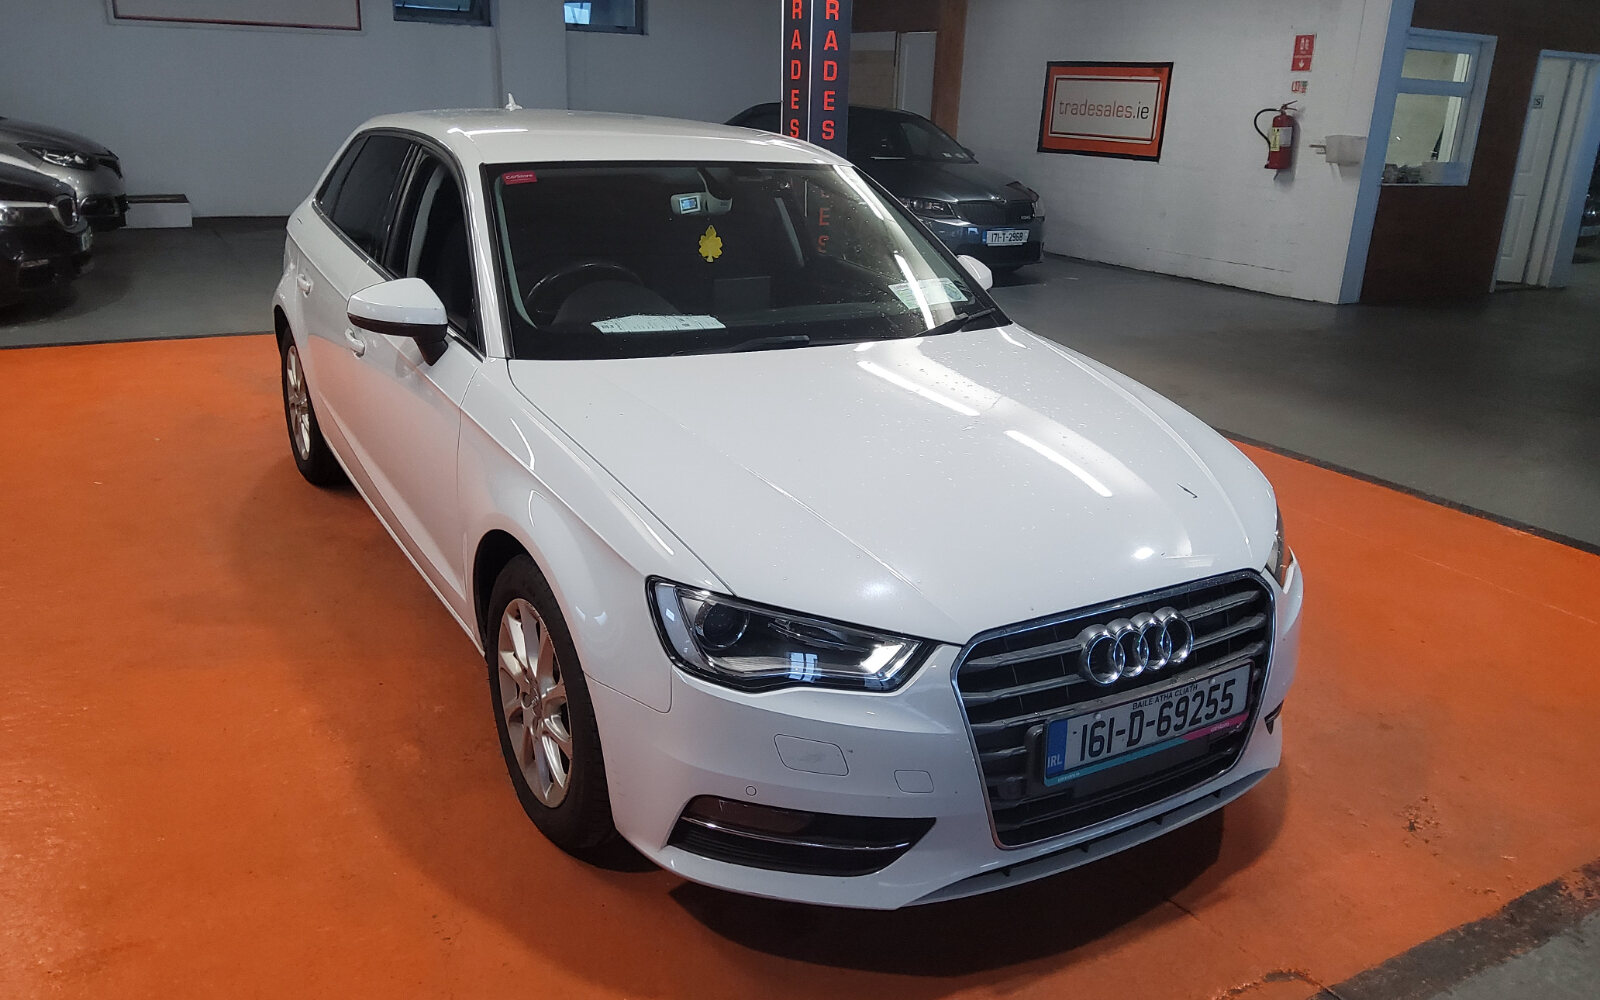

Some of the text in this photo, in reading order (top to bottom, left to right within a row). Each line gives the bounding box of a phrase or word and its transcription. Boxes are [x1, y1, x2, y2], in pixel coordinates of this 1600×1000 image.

[1059, 99, 1150, 119] tradesales.ie
[1132, 683, 1198, 710] BAILE ATHA CLIATH
[1079, 678, 1236, 761] 161-D-69255
[1047, 753, 1063, 768] IRL
